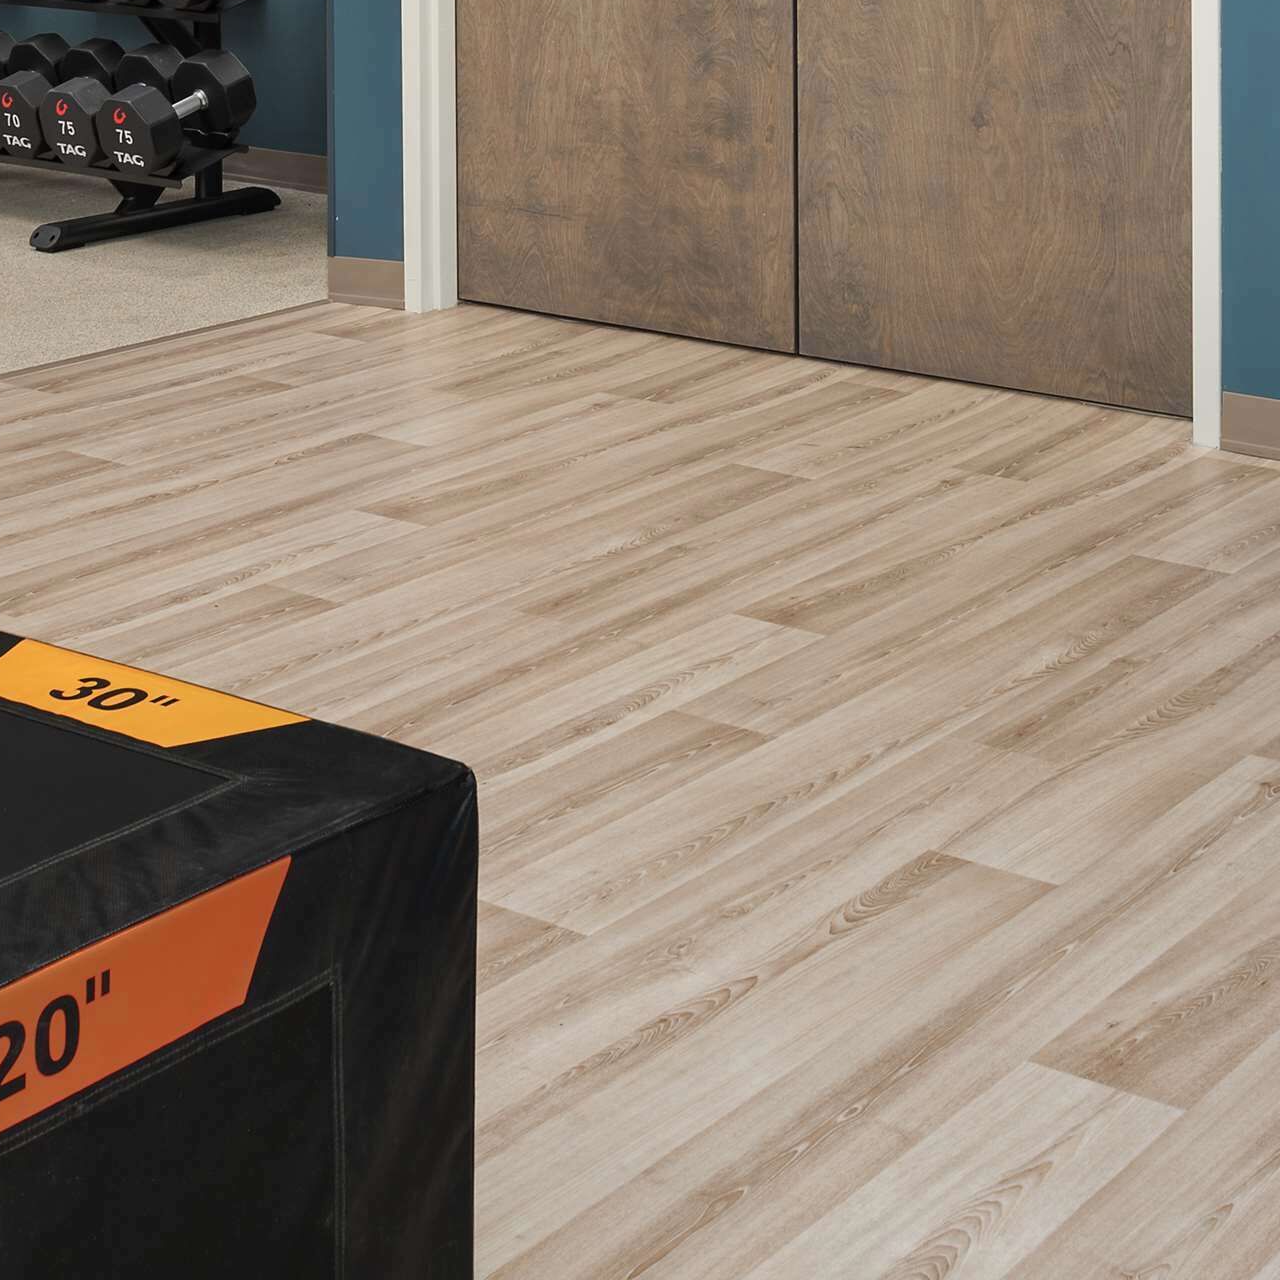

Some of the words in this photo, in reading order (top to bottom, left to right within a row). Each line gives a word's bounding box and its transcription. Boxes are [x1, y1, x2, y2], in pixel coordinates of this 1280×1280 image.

[3, 112, 20, 128] 70
[57, 120, 75, 136] 75
[2, 134, 32, 149] TAG
[115, 128, 134, 144] 75
[56, 142, 87, 157] TAG
[113, 151, 145, 167] TAG
[49, 677, 180, 711] 30"
